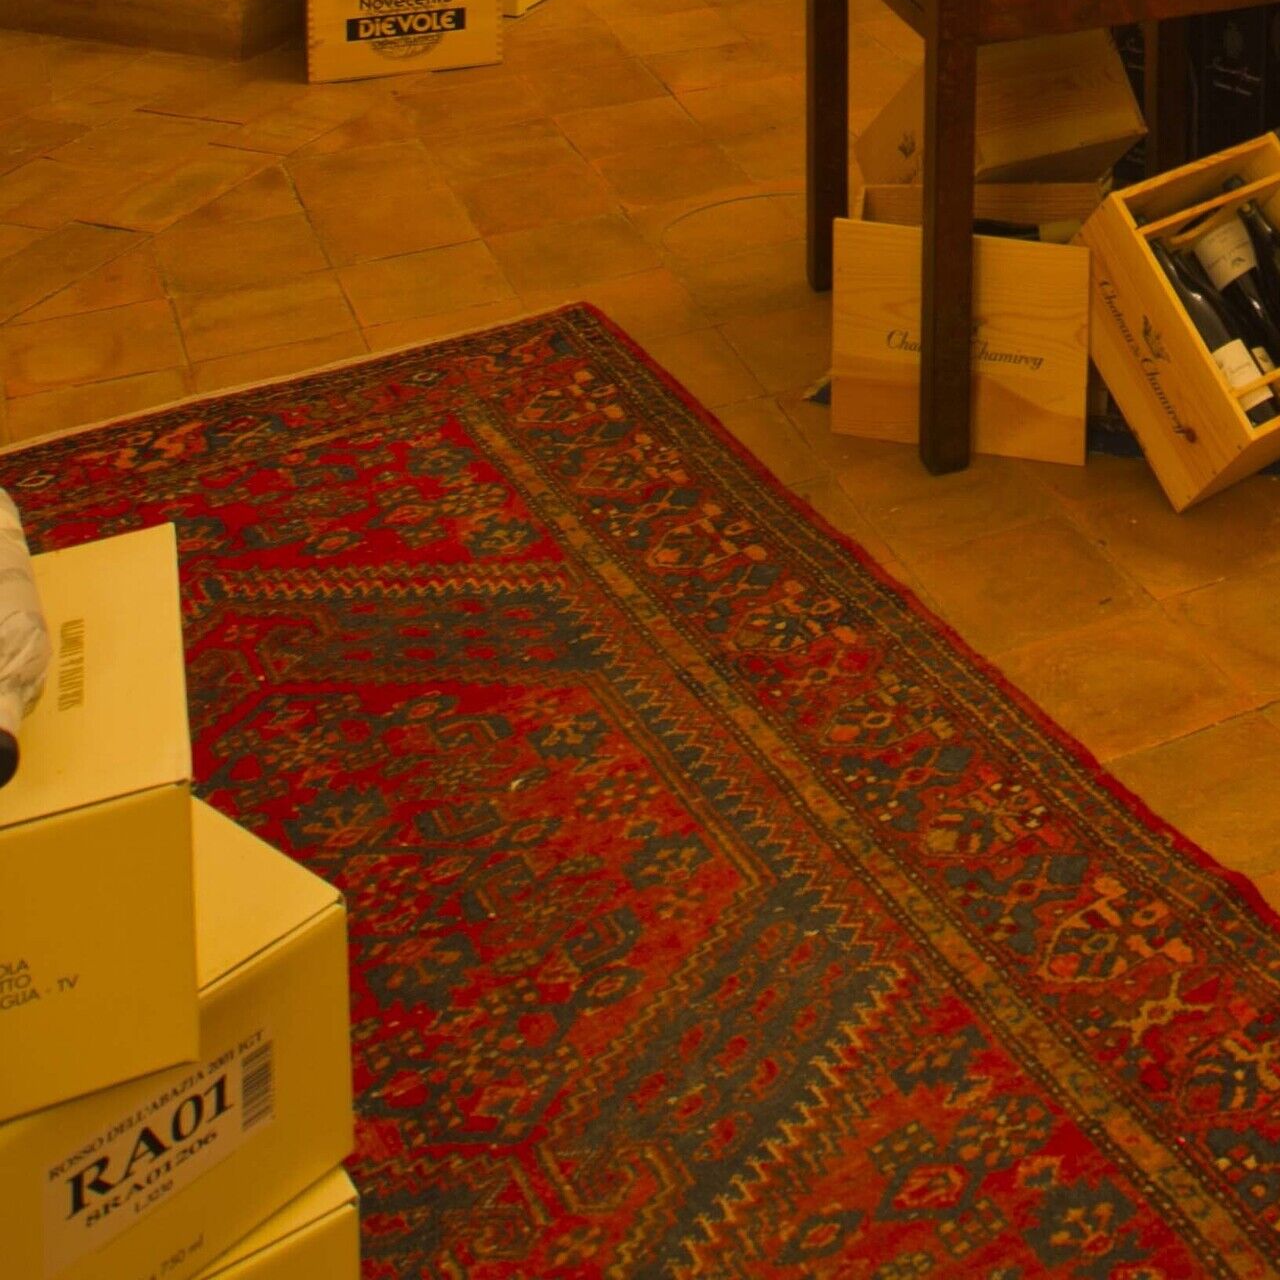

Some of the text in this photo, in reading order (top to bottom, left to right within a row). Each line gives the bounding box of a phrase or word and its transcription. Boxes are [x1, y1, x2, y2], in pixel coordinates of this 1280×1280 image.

[57, 974, 79, 992] TV
[49, 1134, 104, 1180] ROSSO
[65, 1073, 234, 1221] RA01
